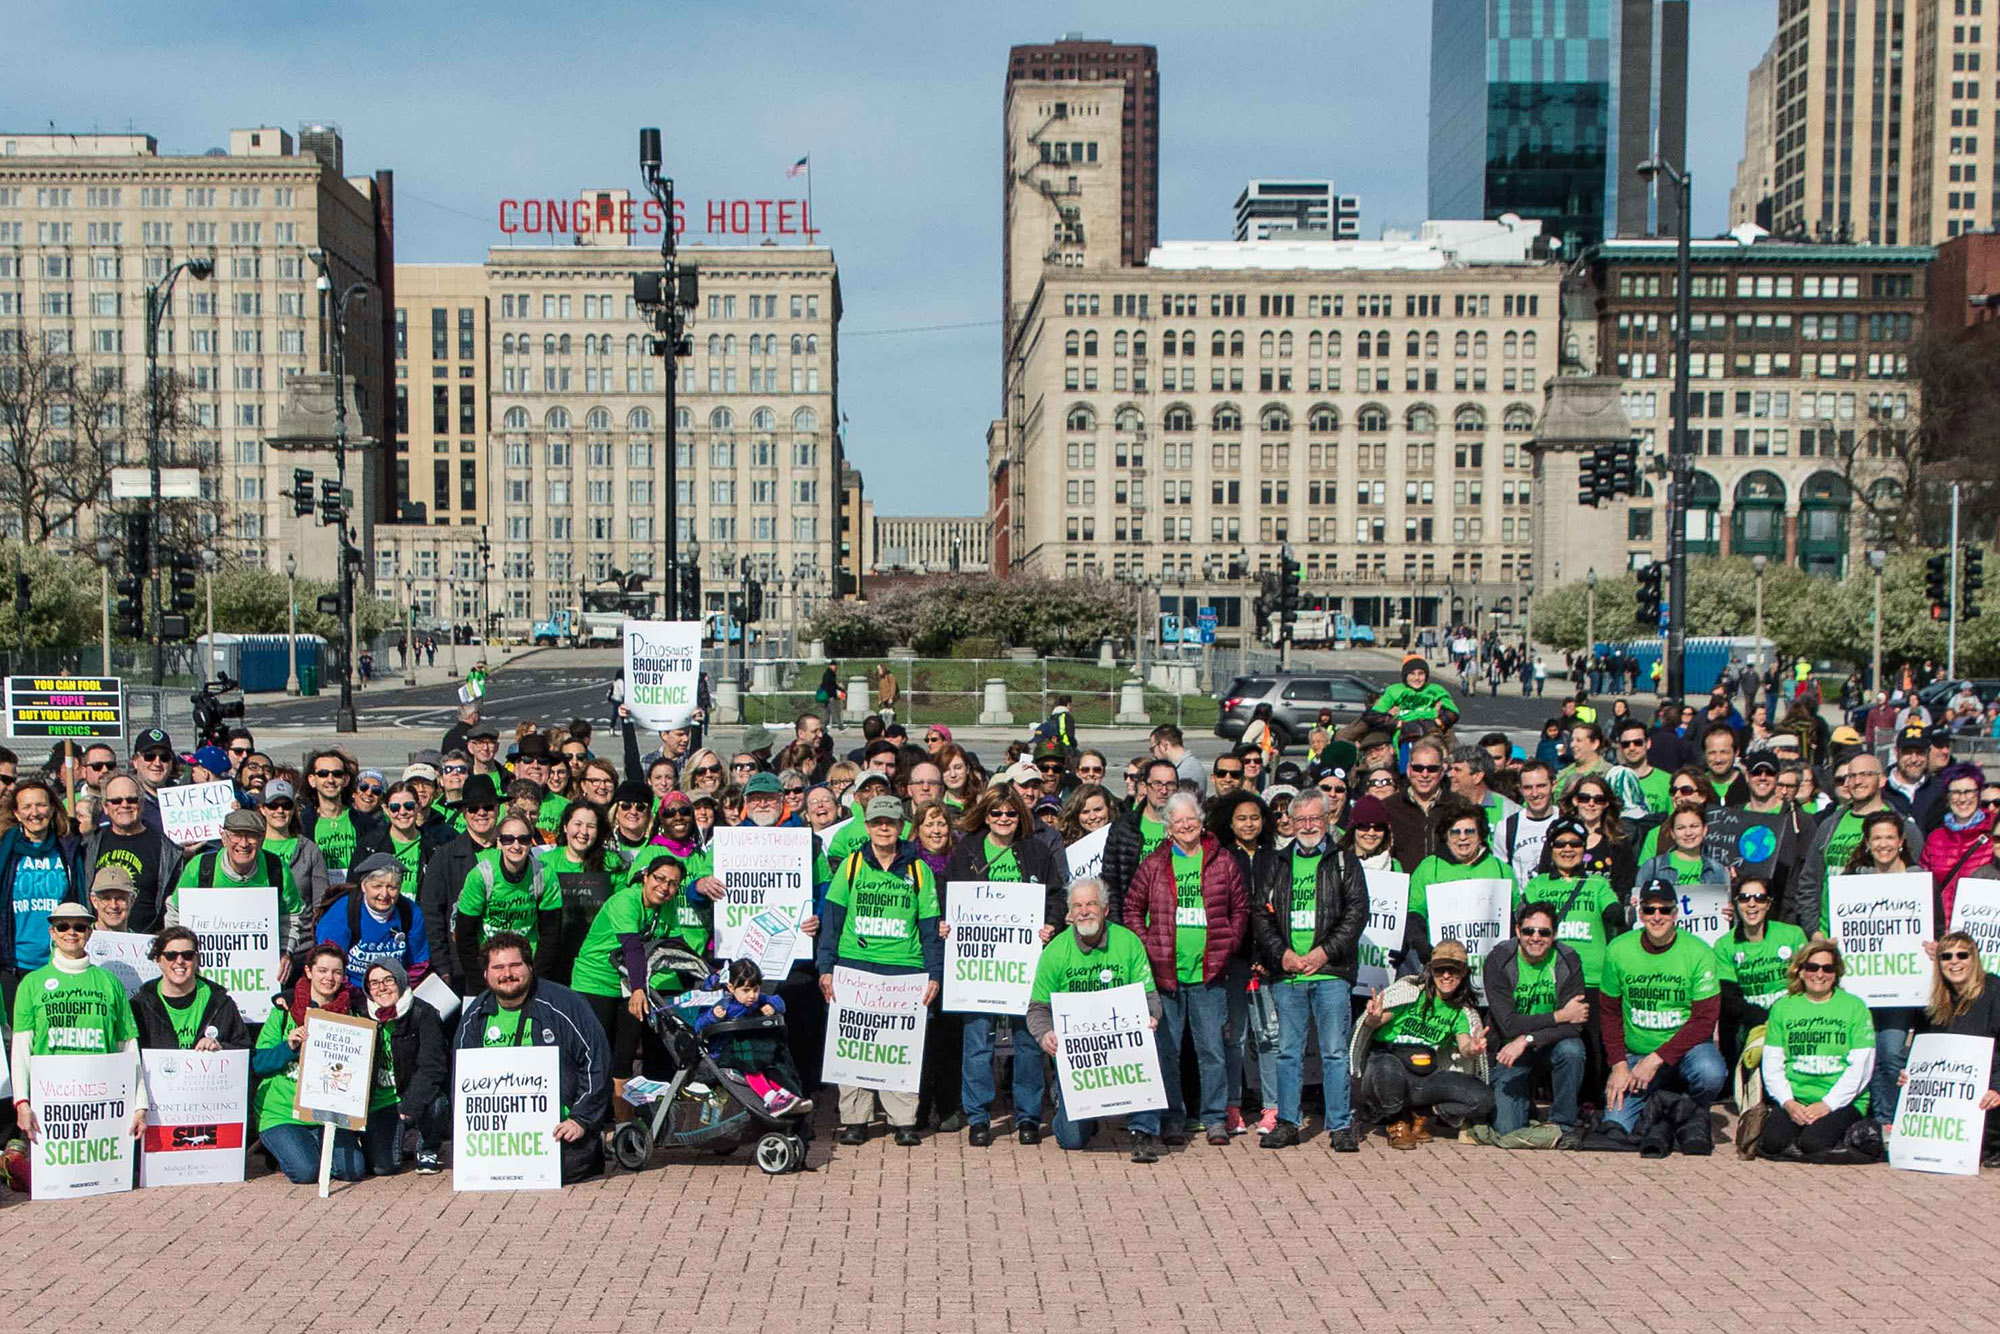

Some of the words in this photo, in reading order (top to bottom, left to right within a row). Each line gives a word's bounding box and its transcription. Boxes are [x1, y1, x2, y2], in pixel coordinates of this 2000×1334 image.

[499, 199, 686, 234] CONGRESS
[707, 199, 821, 234] HOTEL
[633, 658, 679, 672] BROUGHT
[681, 658, 692, 672] TO
[34, 680, 54, 690] YOU
[56, 680, 76, 690] CAN
[78, 680, 102, 691] FOOL
[633, 672, 650, 684] YOU
[652, 673, 664, 685] BY
[50, 696, 85, 705] PEOPLE
[634, 685, 688, 705] SCIENCE.
[18, 710, 39, 720] BUT
[40, 710, 60, 720] YOU
[62, 710, 90, 721] CAN'T
[92, 710, 116, 721] FOOL
[48, 726, 91, 735] PHYSICS
[202, 784, 233, 805] KID
[169, 806, 224, 824] SCIENCE
[168, 825, 212, 841] MADE
[54, 857, 65, 870] A
[726, 872, 783, 888] BROUGHT
[786, 872, 800, 888] TO
[726, 889, 748, 904] YOU
[751, 889, 765, 904] BY
[976, 885, 1005, 899] The
[13, 900, 29, 913] FOR
[31, 899, 58, 911] SCIEN
[857, 893, 899, 906] BROUGHT
[902, 896, 910, 909] TO
[1584, 902, 1595, 912] TO
[1837, 896, 1922, 919] everything:
[856, 906, 872, 917] YOU
[873, 906, 884, 917] BY
[1382, 914, 1396, 930] TO
[1703, 916, 1717, 932] TO
[1842, 920, 1902, 937] BROUGHT
[1905, 919, 1921, 935] TO
[198, 934, 251, 951] ROUGHT
[253, 934, 268, 950] TO
[957, 926, 1015, 944] BROUGHT
[1018, 928, 1032, 944] TO
[957, 944, 979, 957] YOU
[982, 944, 996, 958] BY
[1466, 940, 1479, 953] BY
[1843, 938, 1866, 953] YOU
[1870, 937, 1883, 952] BY
[199, 952, 214, 967] OU
[216, 952, 231, 967] BY
[1844, 953, 1922, 977] SCIENCE.
[956, 959, 1030, 984] SCIENCE.
[838, 971, 922, 995] Understanding
[41, 988, 107, 1002] everything:
[1628, 987, 1671, 1000] BROUGHT
[1674, 989, 1685, 1001] TO
[45, 1002, 93, 1016] BROUGHT
[96, 1004, 107, 1016] TO
[48, 1016, 64, 1028] YOU
[66, 1016, 77, 1027] BY
[840, 1009, 898, 1030] BROUGHT
[900, 1016, 915, 1030] TO
[326, 1033, 352, 1045] READ.
[839, 1024, 860, 1040] YOU
[863, 1028, 878, 1042] BY
[1789, 1031, 1832, 1044] BROUGHT
[1834, 1032, 1846, 1045] TO
[314, 1040, 363, 1056] QUESTION.
[1065, 1034, 1123, 1055] BROUGHT
[1126, 1031, 1143, 1047] TO
[1789, 1044, 1806, 1056] YOU
[1808, 1045, 1818, 1055] BY
[323, 1050, 352, 1063] THINK.
[837, 1038, 911, 1065] SCIENCE.
[1068, 1055, 1091, 1070] YOU
[1094, 1052, 1108, 1066] BY
[1071, 1063, 1151, 1092] SCIENCE.
[1910, 1058, 1978, 1082] everything:
[461, 1071, 548, 1094] everything:
[1908, 1080, 1955, 1098] BROUGHT
[1960, 1083, 1974, 1100] TO
[44, 1103, 106, 1122] BROUGHT
[110, 1101, 124, 1118] TO
[201, 1102, 238, 1111] SCIENCE
[466, 1096, 527, 1114] BROUGHT
[530, 1096, 547, 1113] TO
[1905, 1098, 1921, 1112] YOU
[1922, 1098, 1936, 1114] BY
[45, 1124, 69, 1139] YOU
[72, 1123, 88, 1139] BY
[466, 1115, 489, 1131] YOU
[493, 1115, 508, 1130] BY
[1901, 1114, 1969, 1141] SCIENCE.
[172, 1125, 217, 1147] SUE
[466, 1131, 548, 1157] SCIENCE.
[45, 1137, 122, 1166] SCIENCE.
